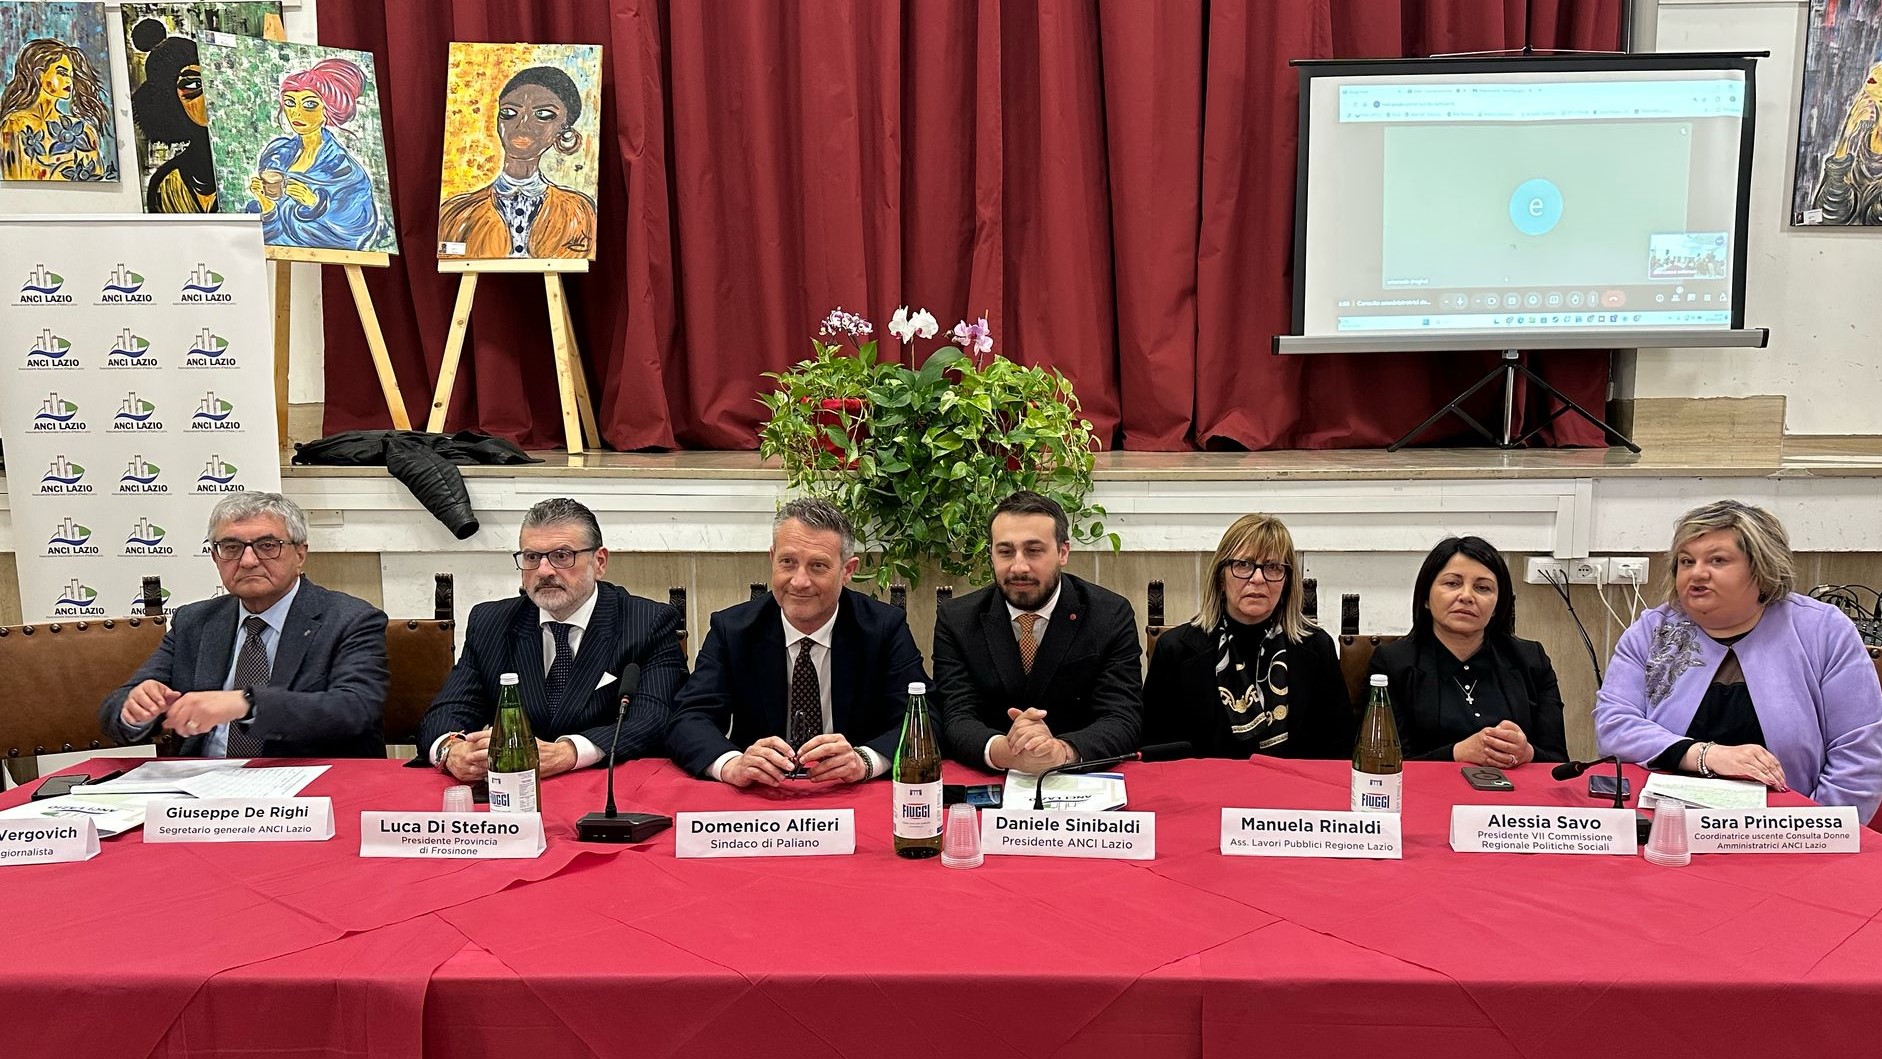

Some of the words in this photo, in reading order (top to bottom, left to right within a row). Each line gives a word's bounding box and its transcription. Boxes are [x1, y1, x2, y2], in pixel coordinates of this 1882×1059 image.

[1528, 196, 1544, 216] e
[20, 295, 42, 303] ANCI
[45, 294, 72, 303] LAZIO
[101, 294, 123, 302] ANCI
[125, 294, 152, 302] LAZIO
[181, 294, 202, 302] ANCI
[205, 293, 232, 302] LAZIO
[26, 359, 49, 367] ANCI
[52, 359, 80, 367] LAZIO
[108, 359, 128, 367] ANCI
[131, 358, 158, 366] LAZIO
[186, 358, 207, 366] ANCI
[209, 358, 236, 366] LAZIO
[33, 422, 56, 430] ANCI
[59, 422, 87, 430] LAZIO
[113, 422, 134, 430] ANCI
[136, 422, 163, 430] LAZIO
[191, 422, 212, 430] ANCI
[213, 421, 240, 430] LAZIO
[40, 485, 62, 493] ANCI
[65, 485, 93, 493] LAZIO
[142, 484, 168, 492] LAZIO
[218, 484, 245, 492] LAZIO
[47, 547, 70, 555] ANCI
[73, 547, 99, 555] LAZIO
[147, 546, 173, 554] LAZIO
[131, 608, 147, 616] ANC
[1361, 792, 1390, 810] FIUGGI
[166, 806, 240, 821] Giuseppe
[244, 806, 265, 818] De
[269, 805, 309, 820] Righi
[902, 803, 931, 820] FIUGGI
[691, 818, 781, 834] Domenico
[786, 817, 839, 832] Alfieri
[996, 816, 1060, 832] Daniele
[1065, 818, 1140, 834] Sinibaldi
[1241, 817, 1314, 833] Manuela
[1320, 819, 1381, 835] Rinaldi
[1487, 813, 1551, 829] Alessia
[1557, 815, 1602, 830] Savo
[1700, 815, 1739, 830] Sara
[1744, 814, 1843, 832] Principessa
[159, 826, 211, 836] Segretario
[213, 825, 256, 835] generale
[258, 825, 284, 833] ANCI
[285, 825, 312, 833] Lazio
[380, 819, 421, 834] Luca
[427, 819, 446, 834] Di
[451, 820, 520, 835] Stefano
[401, 836, 452, 845] Presidente
[454, 837, 498, 846] Provincia
[1477, 830, 1529, 840] Presidente
[1531, 831, 1545, 840] VII
[1547, 832, 1613, 842] Commissione
[1694, 832, 1750, 841] Coordinatrice
[1751, 832, 1784, 840] uscente
[1785, 832, 1822, 840] Consulta
[1823, 832, 1850, 840] Donne
[710, 838, 758, 849] Sindaco
[761, 838, 773, 849] di
[776, 837, 820, 848] Paliano
[1002, 835, 1064, 848] Presidente
[1067, 838, 1098, 849] ANCI
[1101, 839, 1133, 850] Lazio
[1230, 838, 1249, 847] Ass.
[1251, 838, 1282, 848] Lavori
[1284, 839, 1322, 849] Pubblici
[1324, 841, 1365, 851] Regione
[1367, 842, 1394, 852] Lazio
[1481, 840, 1530, 851] Regionale
[1532, 841, 1575, 851] Politiche
[1577, 842, 1610, 851] Sociali
[1716, 842, 1780, 850] Amministratrici
[1781, 841, 1803, 849] ANCI
[1804, 841, 1827, 849] Lazio
[0, 848, 54, 859] giornalista
[419, 846, 429, 854] di
[431, 846, 478, 856] Frosinone
